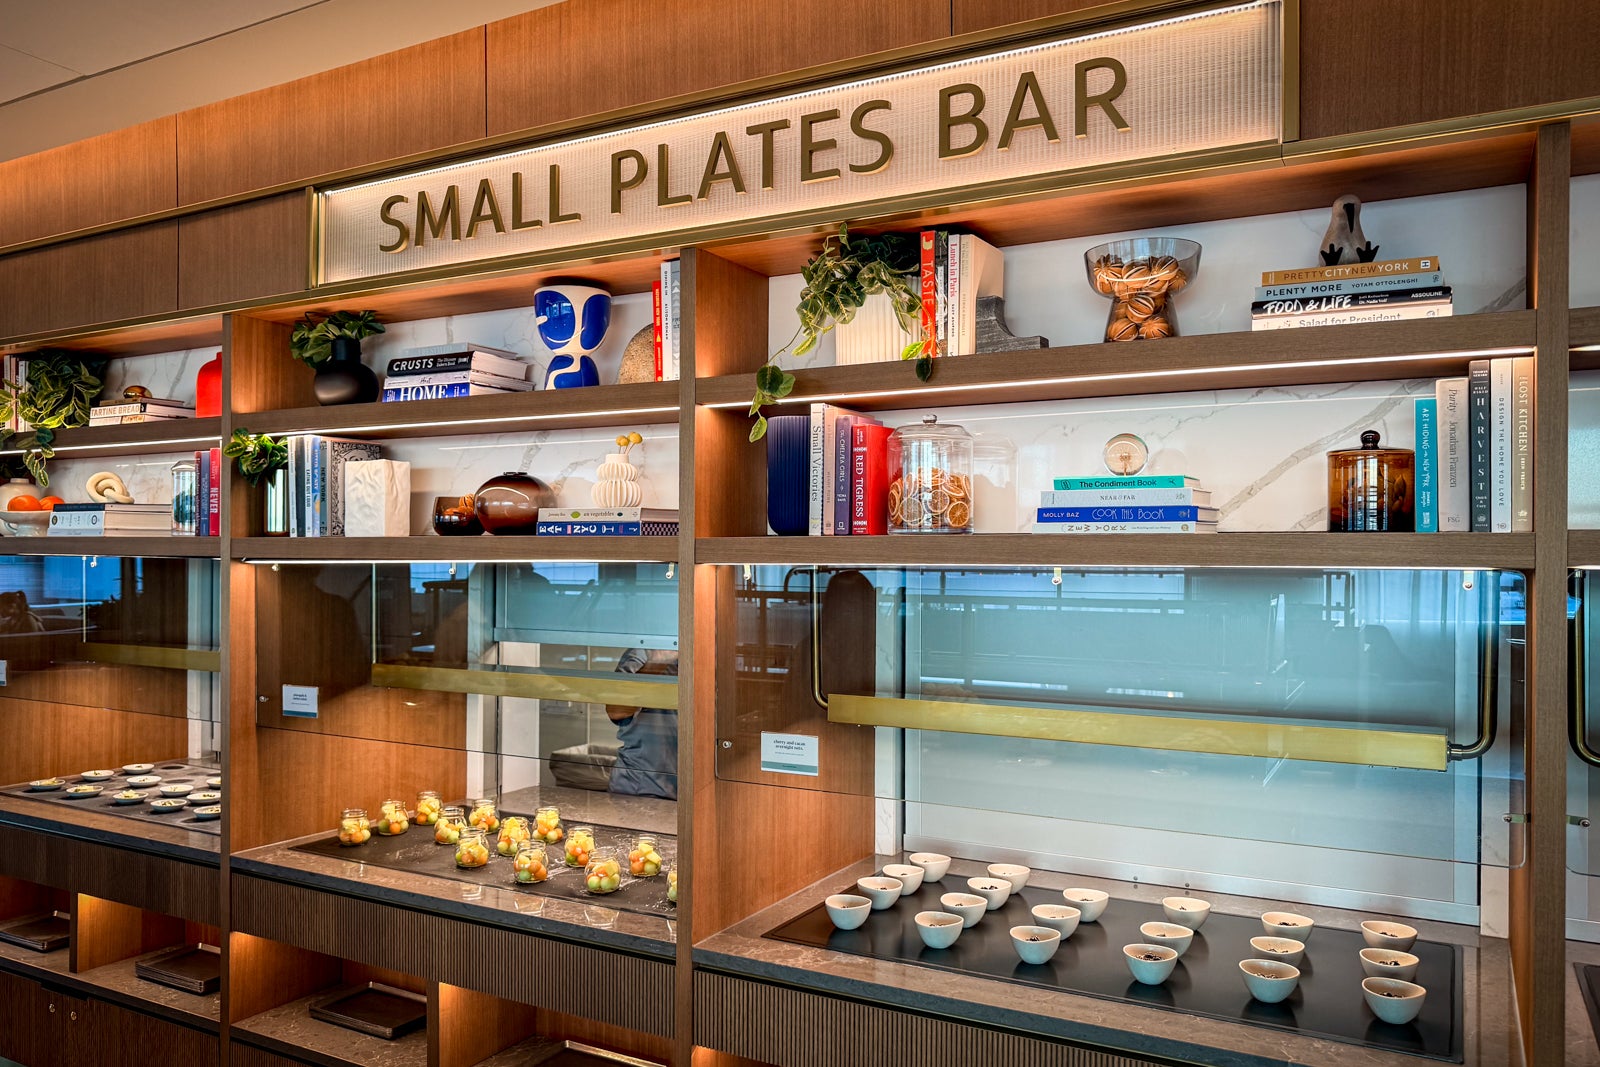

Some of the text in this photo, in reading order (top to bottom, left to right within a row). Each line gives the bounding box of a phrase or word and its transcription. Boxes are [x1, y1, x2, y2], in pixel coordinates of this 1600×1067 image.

[379, 56, 1132, 254] SMALL PLATES BAR
[922, 260, 934, 305] TASTE
[1266, 284, 1342, 296] PLENTY MORE
[1376, 278, 1418, 286] OTTOLENGHI
[1262, 298, 1303, 315] FOOD
[1305, 300, 1320, 312] &
[1300, 318, 1328, 327] Salad
[1330, 316, 1346, 324] for
[1350, 312, 1401, 323] President
[393, 358, 434, 371] CRUSTS
[400, 384, 448, 401] HOME
[1519, 382, 1528, 404] LOST
[91, 405, 140, 416] TARTINE BREAD
[1447, 389, 1458, 488] Purity Jonathan Franzen
[1519, 409, 1528, 451] KITCHEN
[1476, 398, 1485, 490] HARVEST
[812, 426, 821, 502] Small Victories
[210, 488, 218, 513] NEVER
[1092, 508, 1117, 520] COOK
[1122, 509, 1134, 519] THIS
[540, 524, 597, 534] EAT NYC
